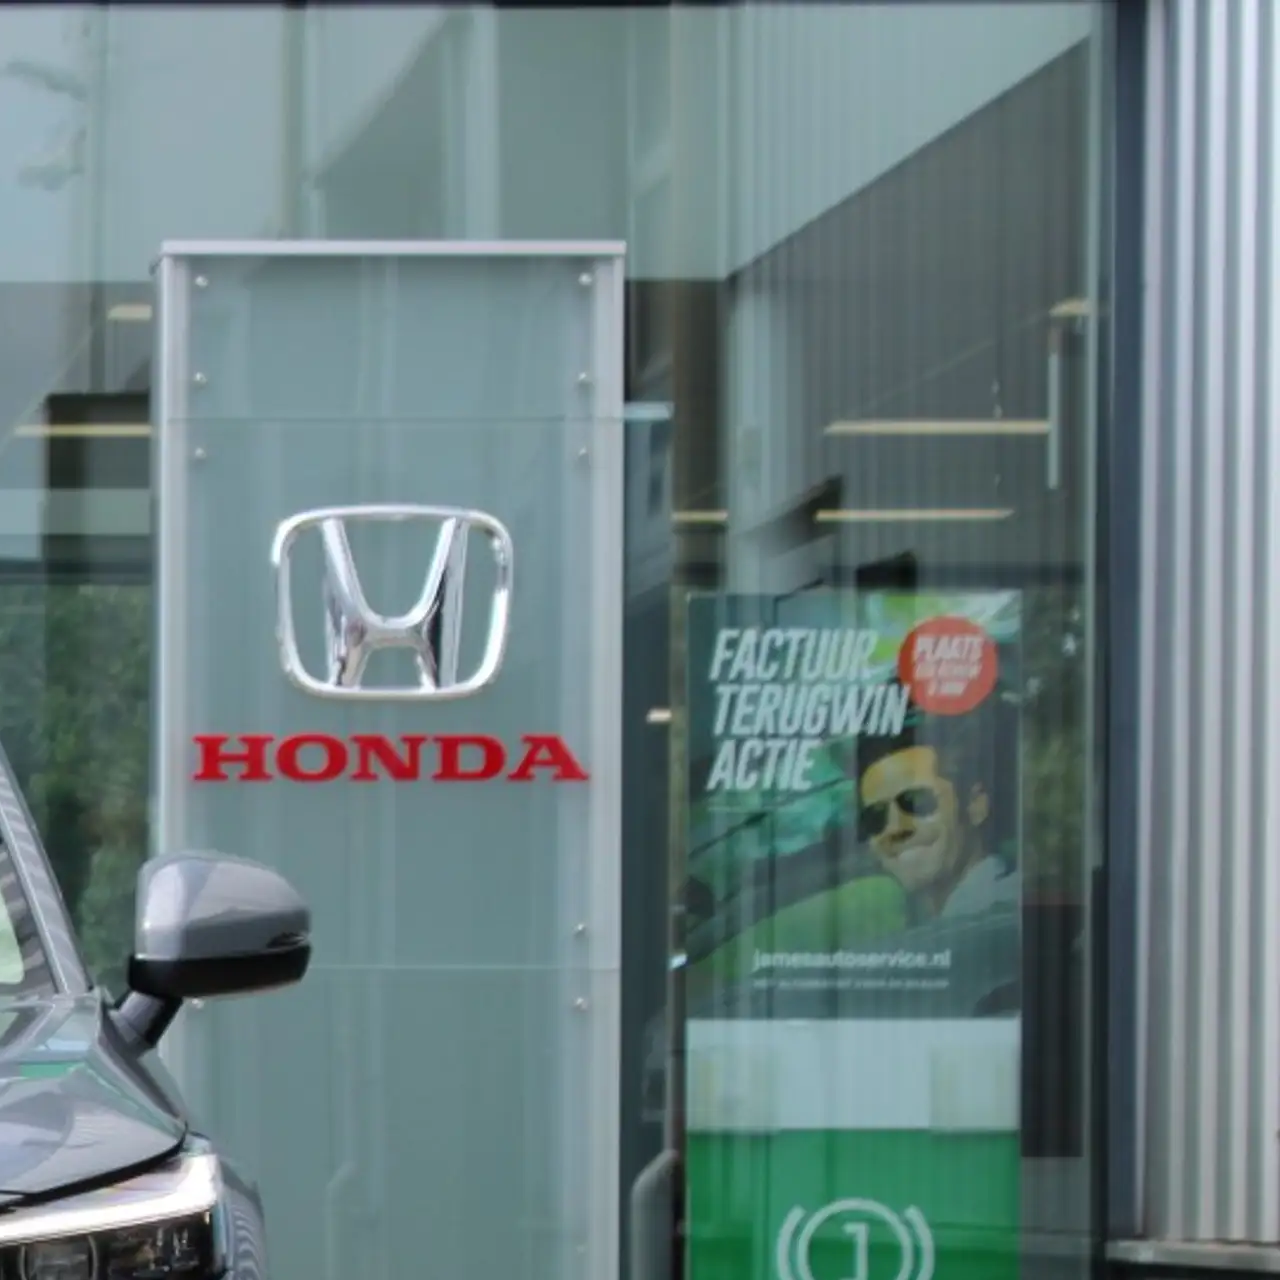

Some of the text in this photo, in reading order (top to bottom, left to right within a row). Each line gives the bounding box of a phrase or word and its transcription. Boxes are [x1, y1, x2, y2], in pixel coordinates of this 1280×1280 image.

[709, 628, 879, 681] FACTUUR
[713, 683, 910, 736] TERUGWIN
[192, 734, 590, 782] HONDA
[706, 738, 820, 790] ACTIE
[752, 948, 952, 972] jamesautoservice.nl
